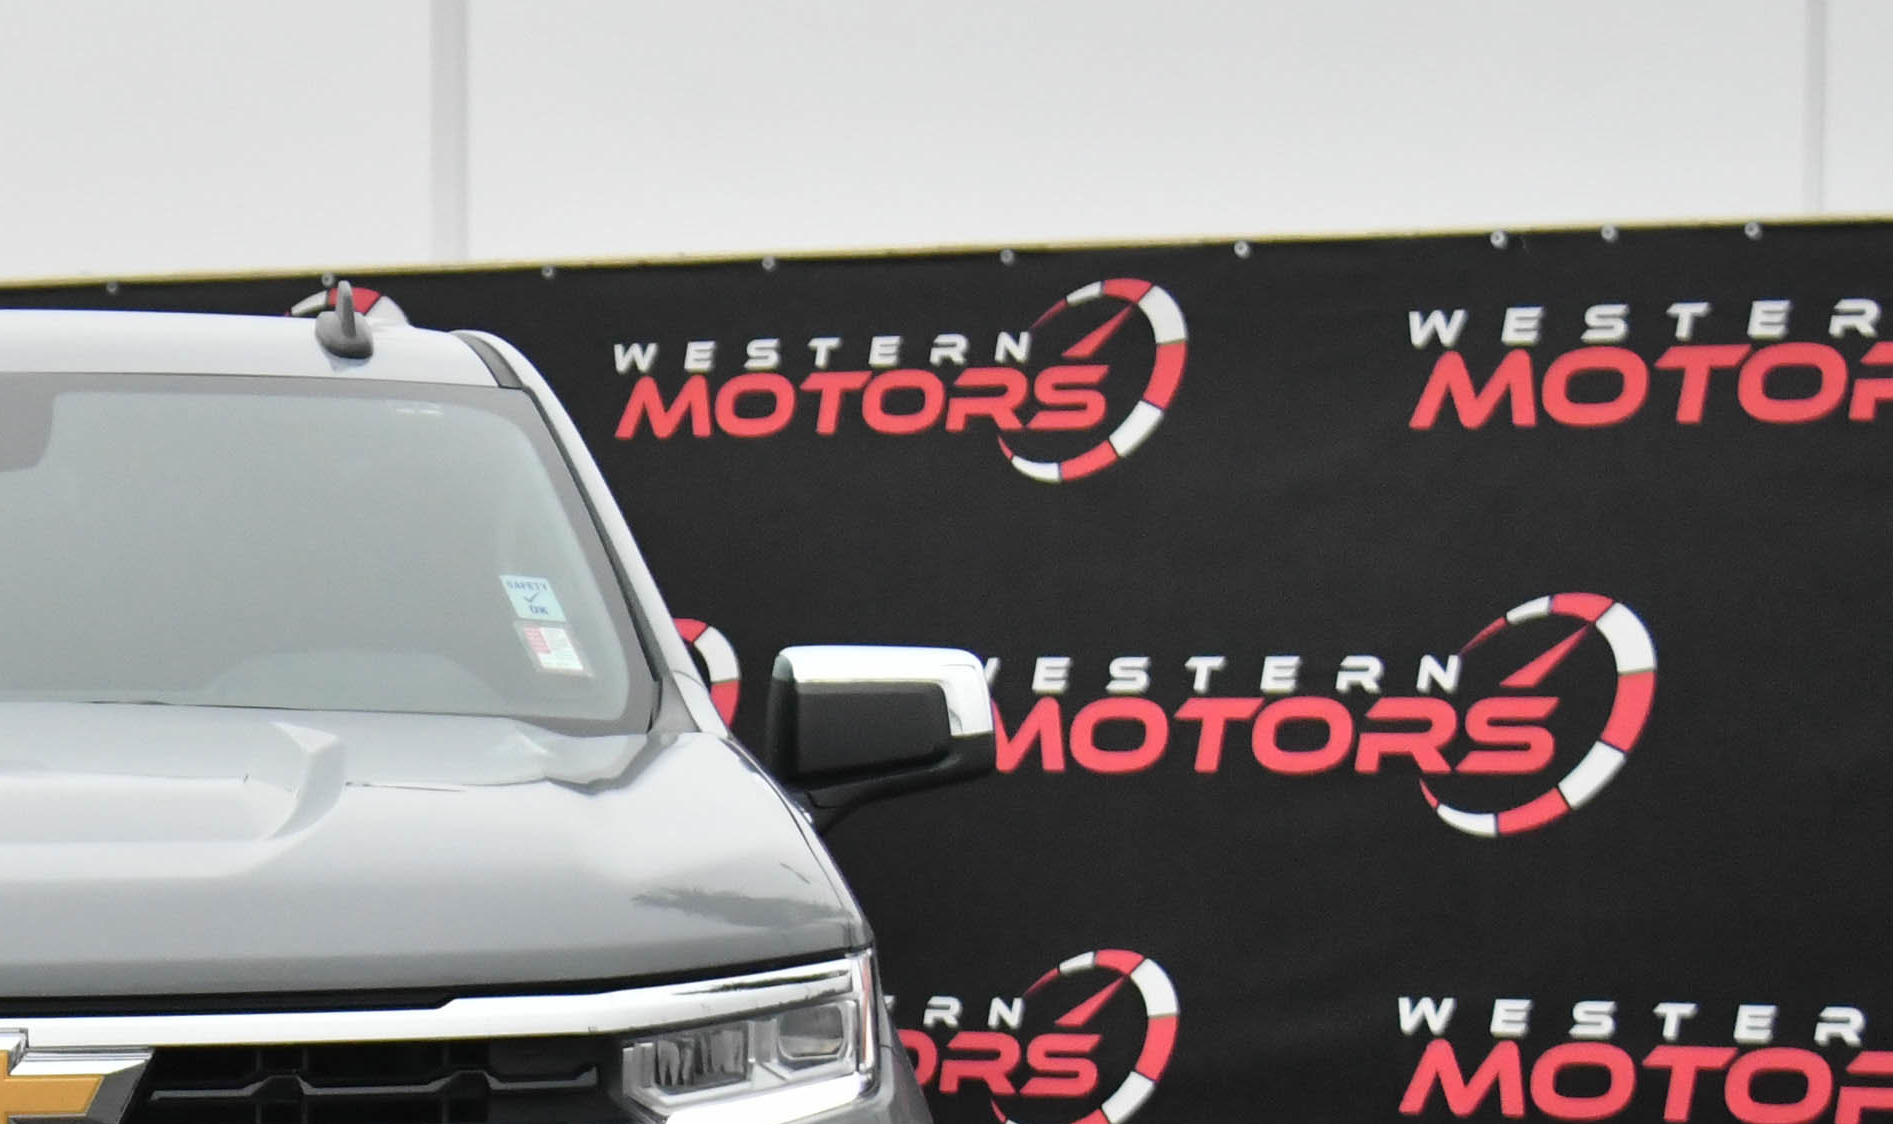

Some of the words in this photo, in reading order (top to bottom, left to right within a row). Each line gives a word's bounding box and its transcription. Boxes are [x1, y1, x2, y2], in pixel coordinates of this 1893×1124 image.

[614, 331, 1031, 373] WESTERN
[615, 364, 1109, 440] MOTORS
[992, 695, 1559, 774] MOTORS
